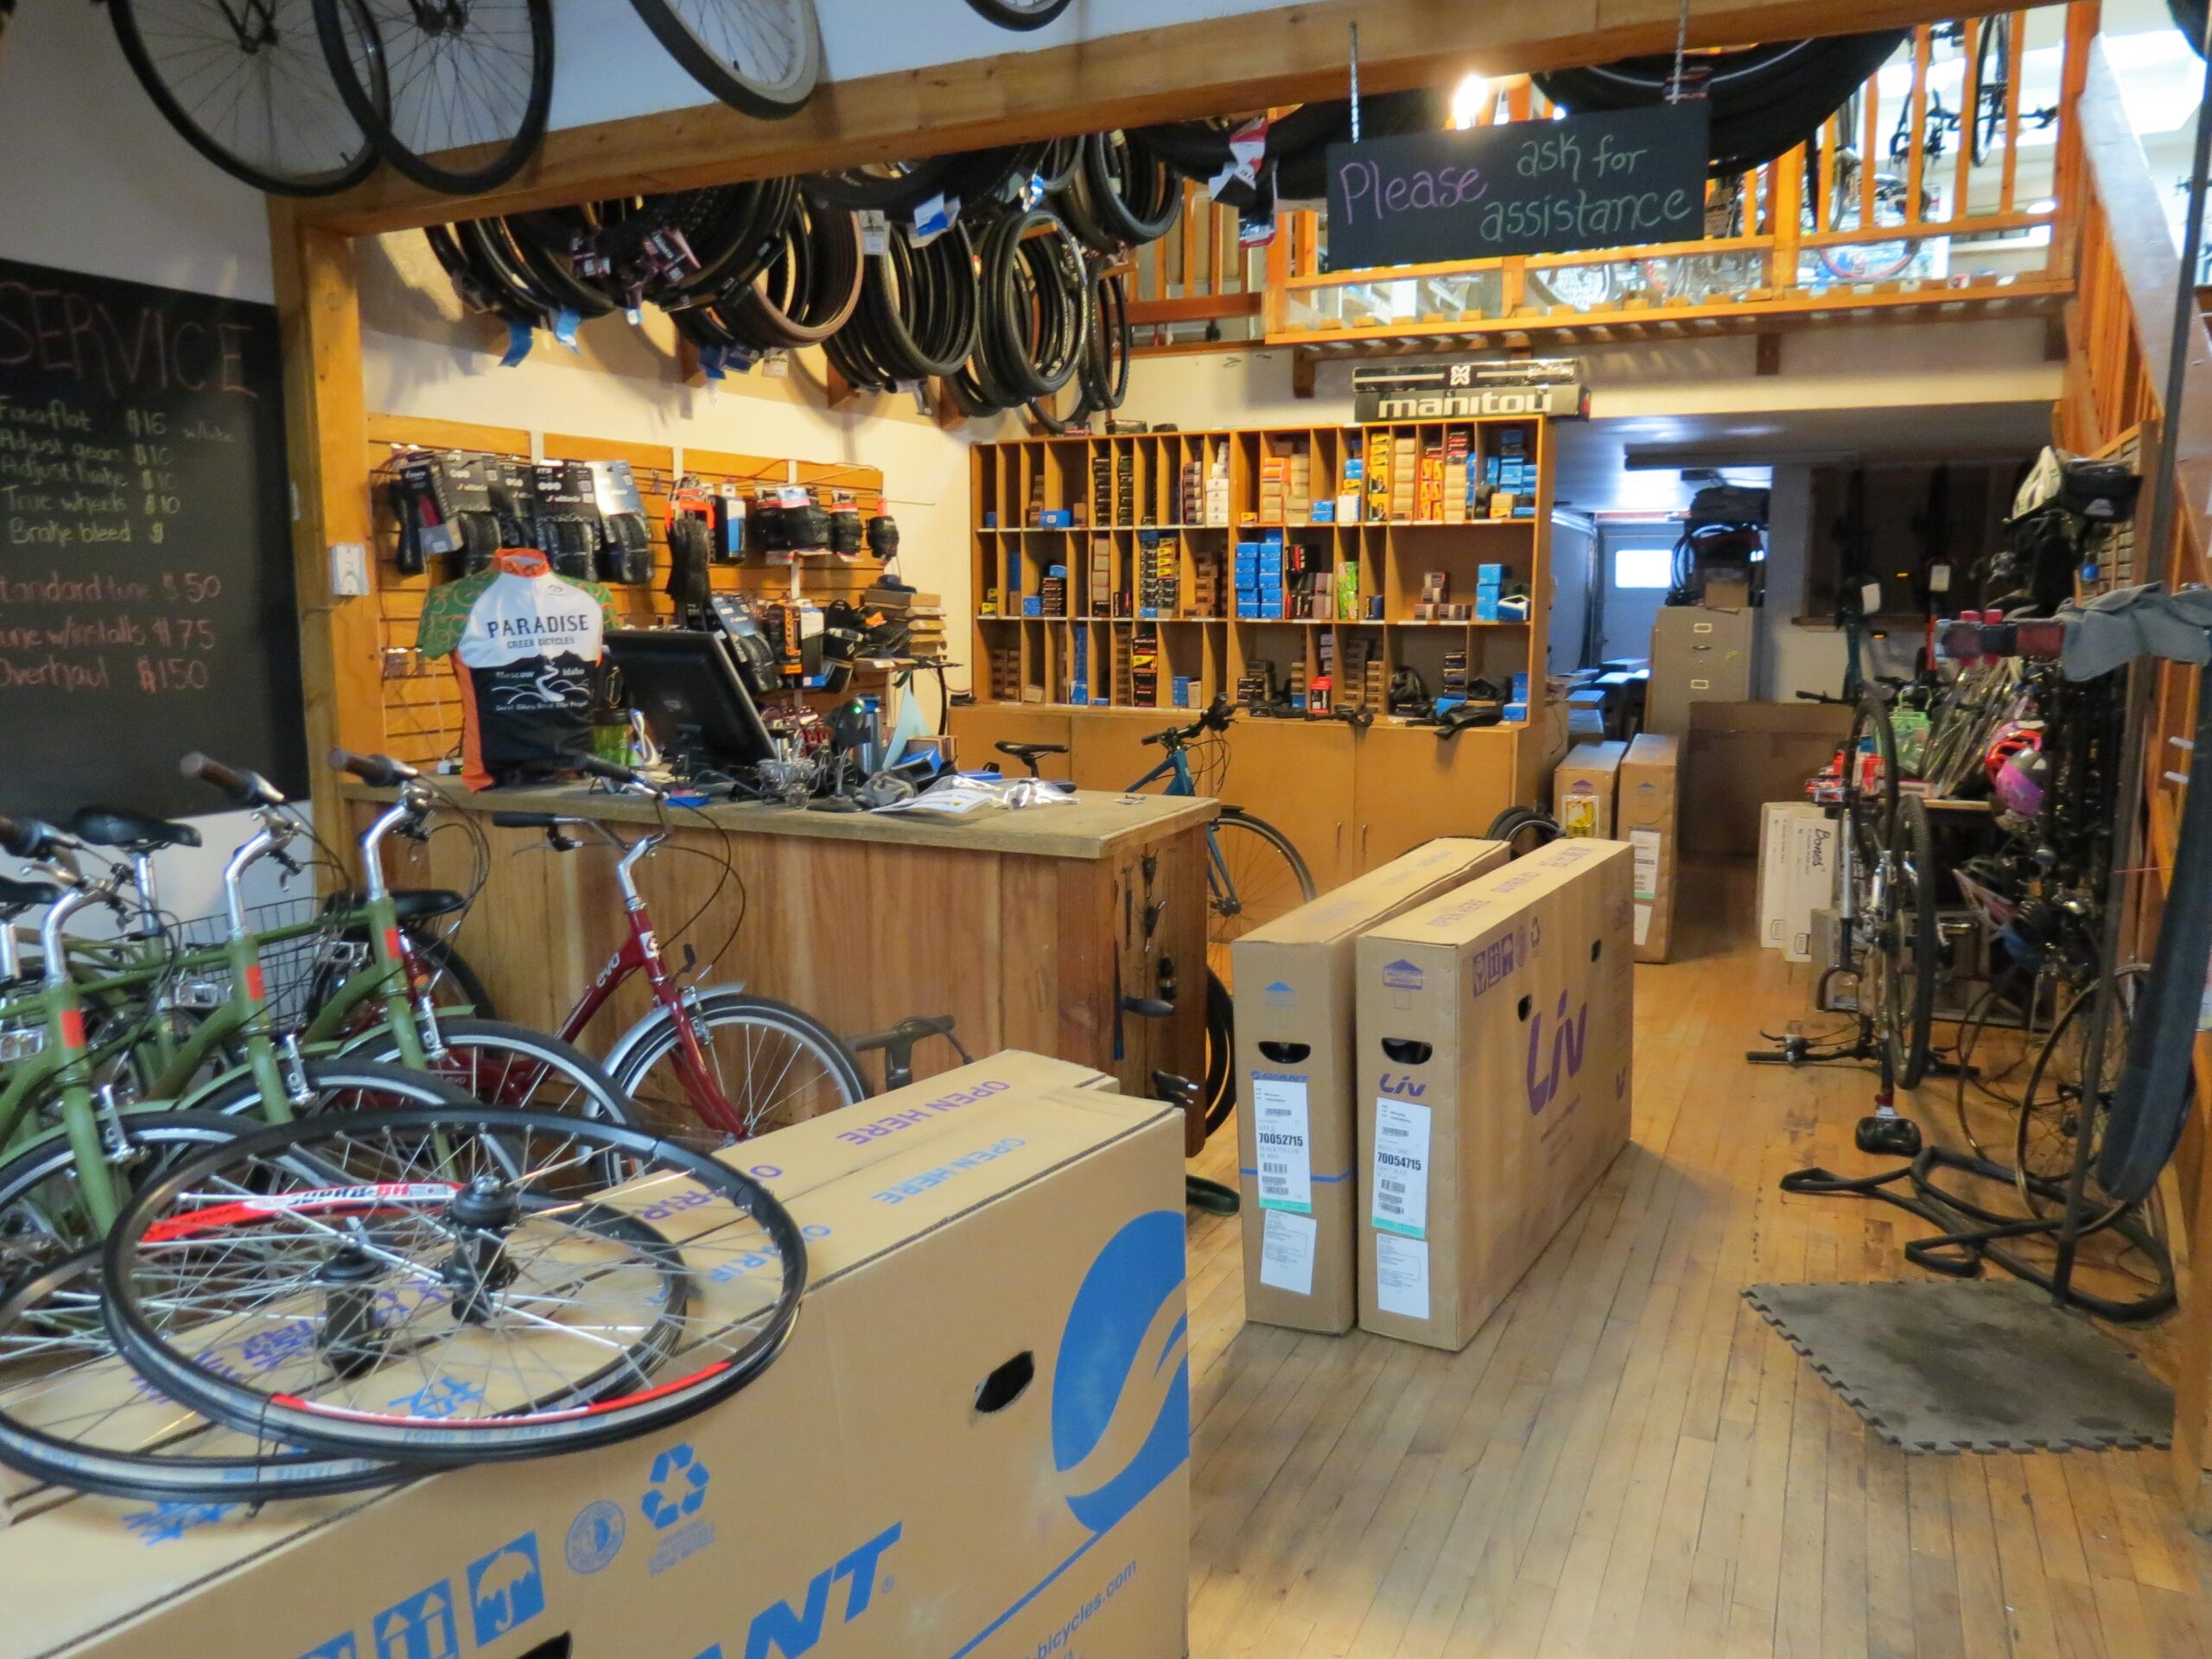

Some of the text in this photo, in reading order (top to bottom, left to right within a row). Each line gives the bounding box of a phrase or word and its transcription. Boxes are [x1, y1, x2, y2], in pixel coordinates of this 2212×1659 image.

[1516, 133, 1648, 182] ask for
[1339, 160, 1488, 225] Please
[1480, 188, 1691, 243] assistance
[0, 282, 259, 399] SERVICE
[1378, 391, 1554, 418] manitou
[10, 516, 73, 548] Brake
[77, 518, 131, 544] bleed
[486, 614, 590, 639] PARADISE
[506, 636, 575, 649] CREEK BICYCLES
[137, 655, 208, 693] $150
[562, 667, 585, 676] Idaho
[596, 952, 620, 988] evo
[1526, 989, 1588, 1116] Liv
[1380, 1073, 1427, 1097] Liv
[836, 1080, 1012, 1145] OPEN HERE
[1258, 1132, 1303, 1147] 70052715
[871, 1137, 1027, 1205] OPEN HERE
[1377, 1152, 1421, 1171] 70054715
